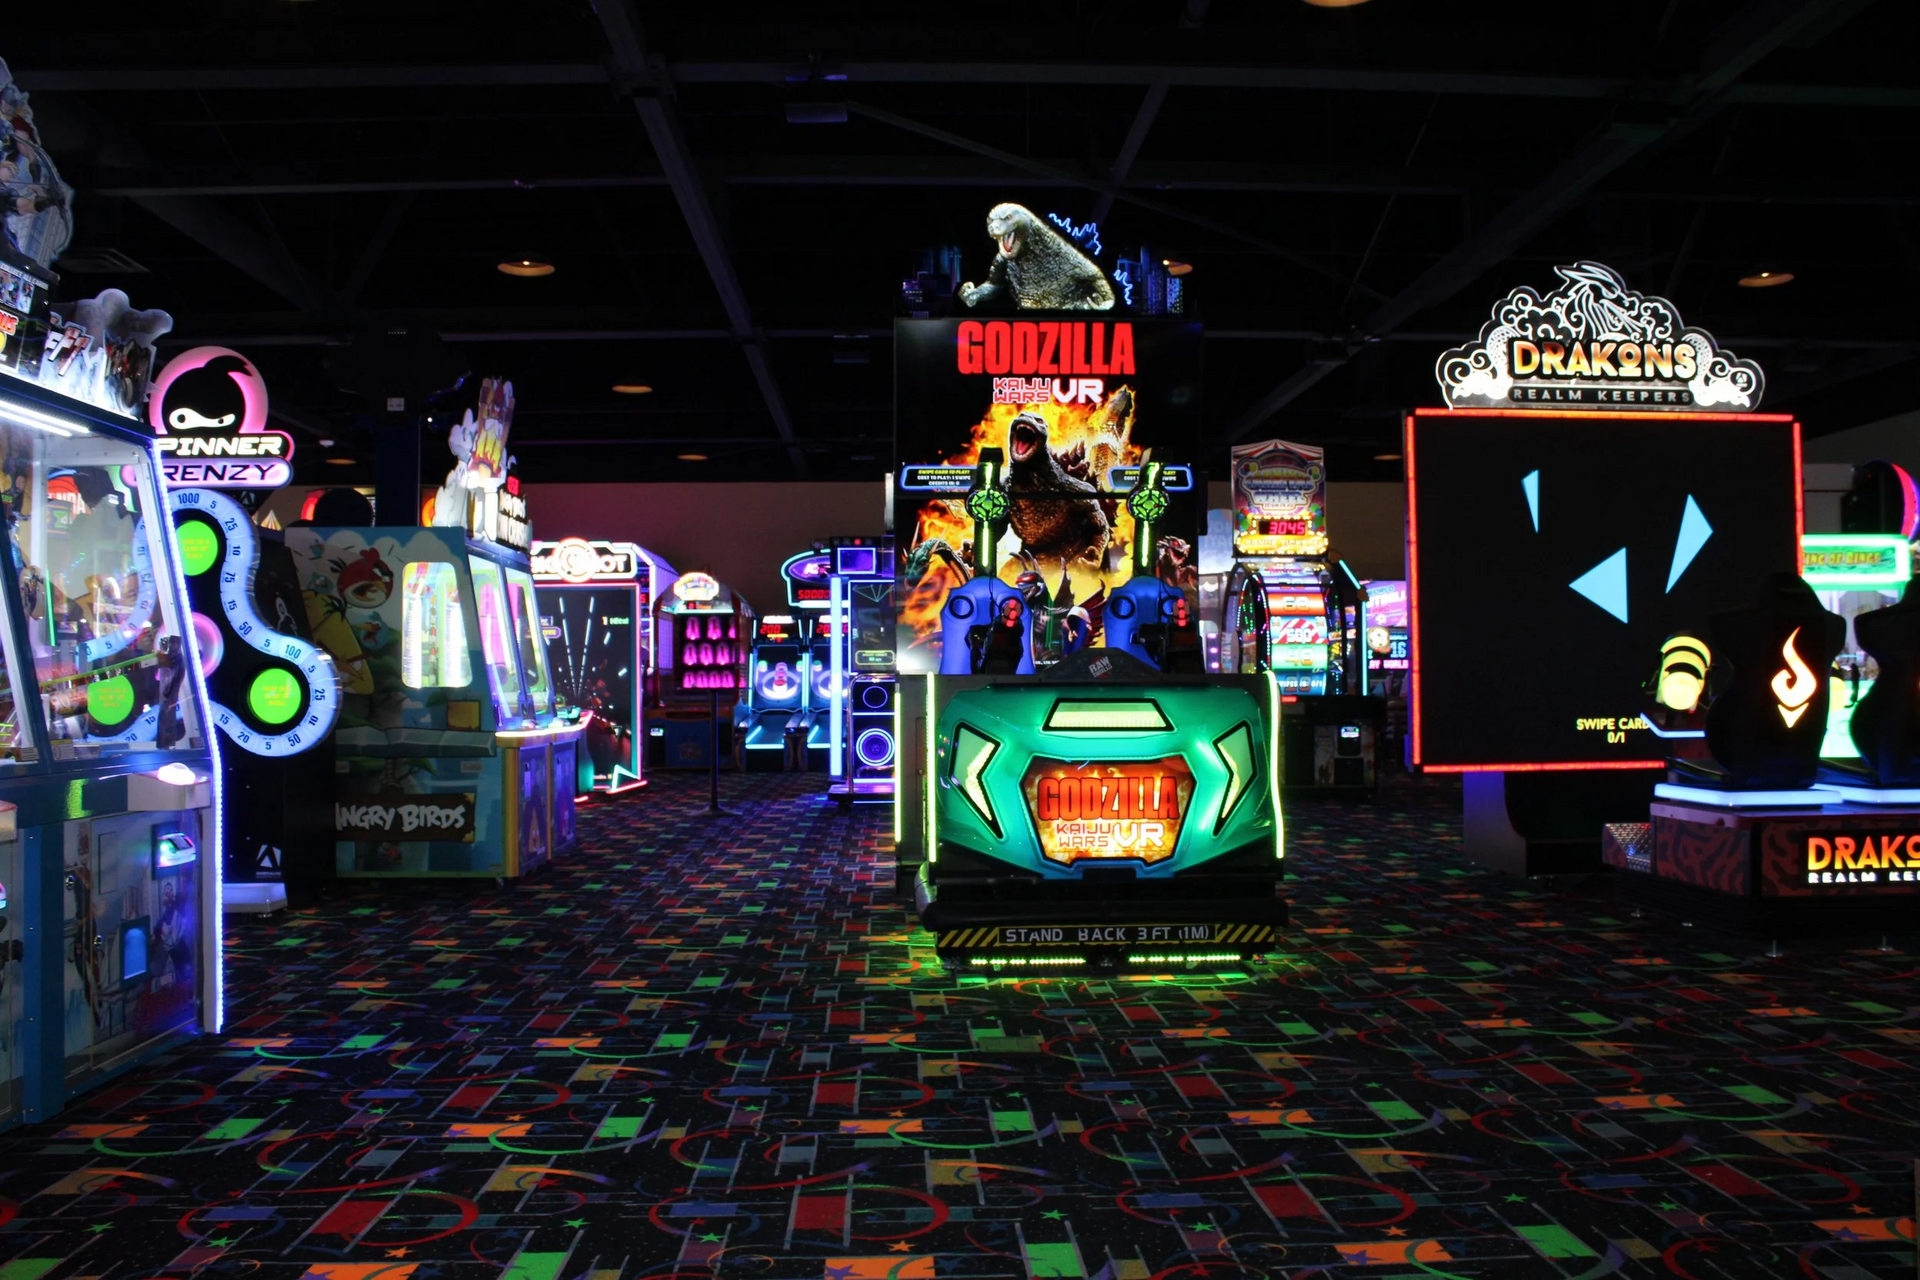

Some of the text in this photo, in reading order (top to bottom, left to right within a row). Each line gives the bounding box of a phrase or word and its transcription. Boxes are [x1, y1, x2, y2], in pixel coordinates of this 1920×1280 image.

[957, 320, 1136, 375] GODZILLA
[1513, 340, 1698, 380] DRAKONS
[993, 377, 1051, 391] KAIJU
[1052, 378, 1104, 404] VR
[993, 391, 1051, 405] WARS
[1513, 388, 1690, 403] REALM KEEPERS
[157, 437, 282, 456] PINNER
[163, 464, 276, 481] RENZY
[177, 493, 200, 504] 1000
[209, 500, 218, 509] 5
[224, 517, 238, 531] 25
[1269, 521, 1306, 535] 3045
[232, 546, 241, 556] 10
[1804, 552, 1826, 566] ING
[224, 572, 236, 583] 75
[227, 599, 238, 611] 15
[239, 621, 253, 635] 50
[263, 638, 271, 648] 5
[285, 644, 301, 659] 100
[308, 665, 316, 673] 5
[1088, 656, 1112, 673] RAW
[314, 688, 325, 701] 25
[219, 713, 230, 725] 15
[308, 715, 319, 726] 10
[1576, 718, 1615, 730] SWIPE
[237, 731, 250, 744] 20
[287, 733, 301, 747] 50
[1607, 731, 1625, 743] 0/1
[265, 741, 272, 750] 5
[1038, 777, 1180, 820] GODZILLA
[397, 804, 466, 832] BIRDS
[1056, 823, 1111, 834] KAIJU
[1113, 822, 1165, 847] VR
[1059, 836, 1109, 848] WARS
[1807, 835, 1920, 870] DRAKO
[1807, 871, 1877, 883] REALM
[1006, 928, 1063, 942] STAND
[1078, 927, 1127, 941] BACK
[1137, 927, 1148, 940] 3
[1151, 926, 1171, 940] FT
